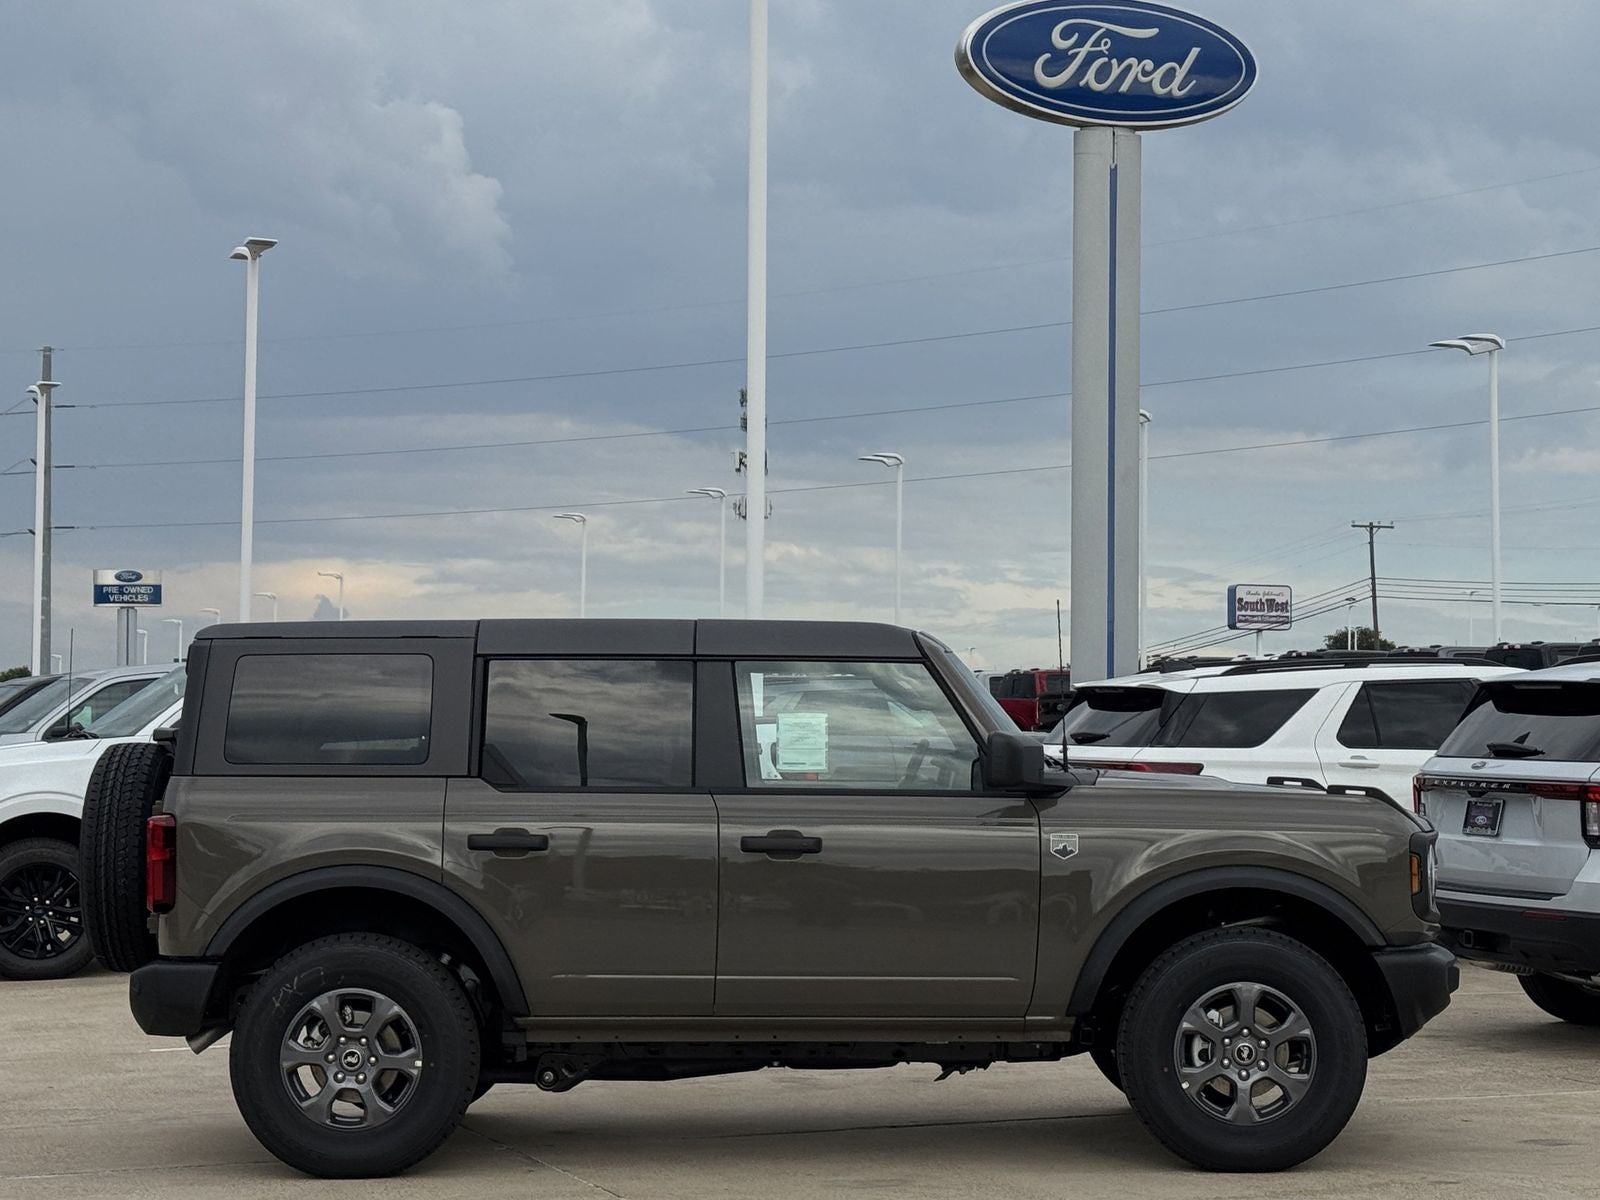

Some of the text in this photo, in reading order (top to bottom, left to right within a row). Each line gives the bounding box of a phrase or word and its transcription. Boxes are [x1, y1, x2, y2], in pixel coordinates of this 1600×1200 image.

[1034, 18, 1201, 97] Ford
[108, 594, 149, 602] VEHICLES
[1434, 780, 1511, 789] EXPLORER
